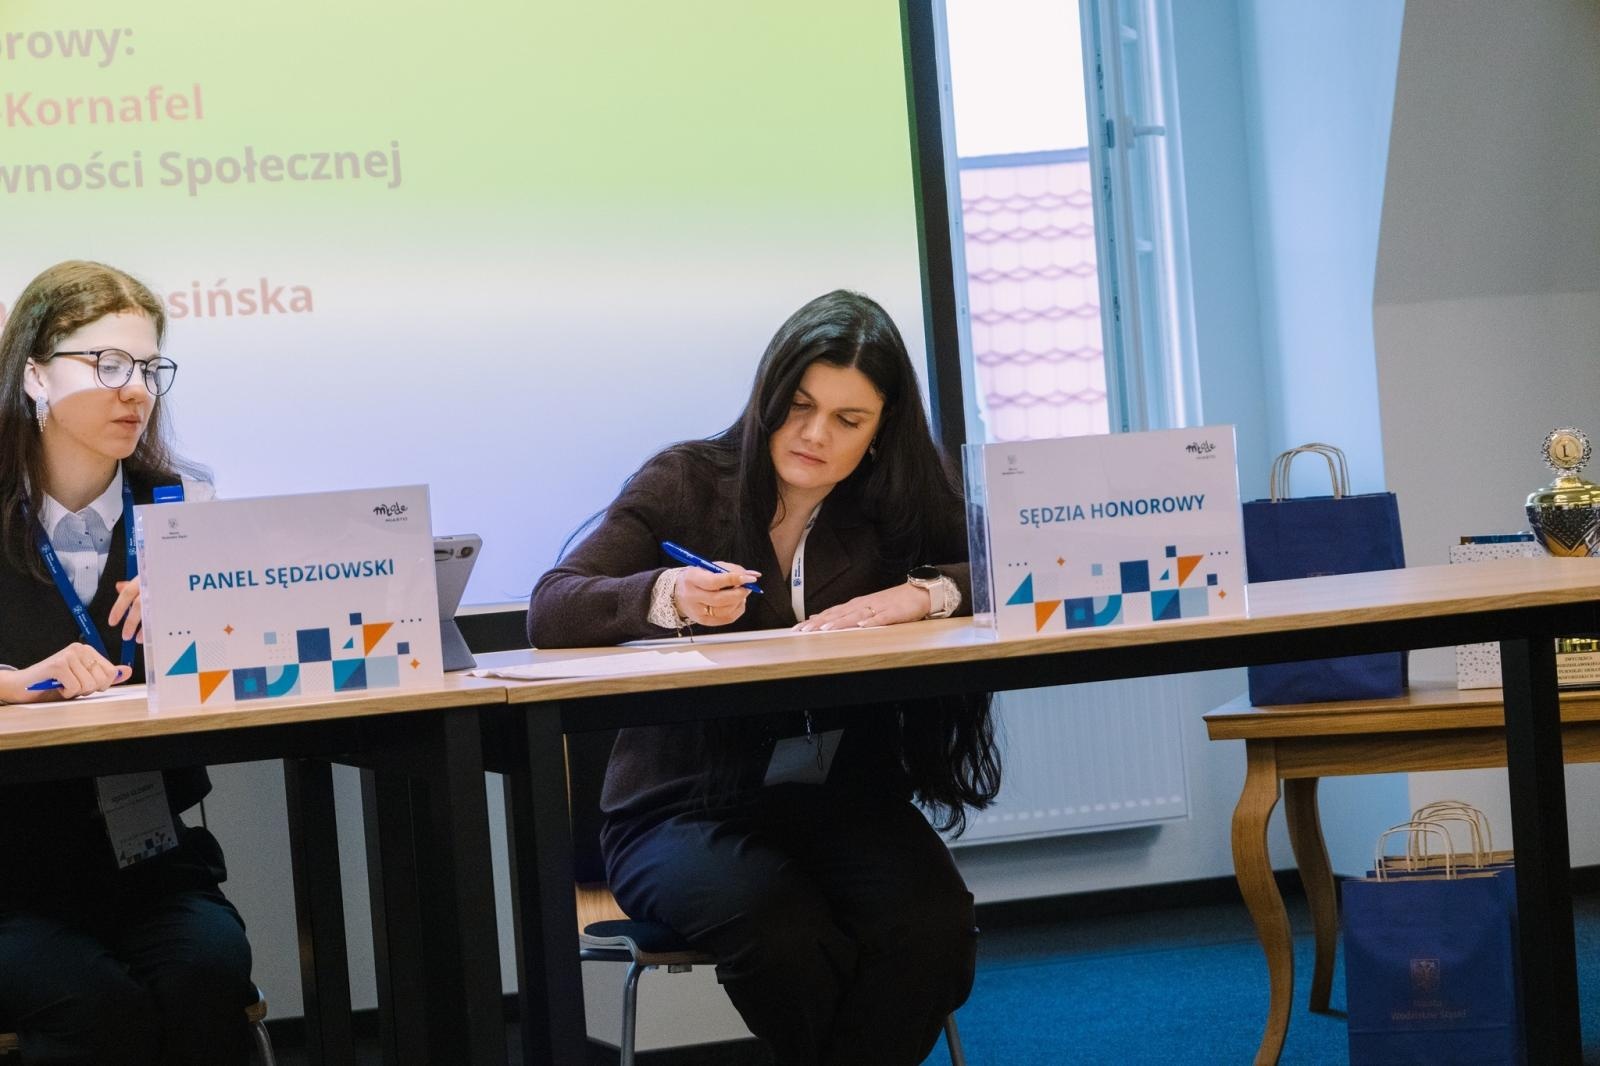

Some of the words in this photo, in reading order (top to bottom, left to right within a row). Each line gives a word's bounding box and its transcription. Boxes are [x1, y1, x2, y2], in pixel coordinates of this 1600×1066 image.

[0, 27, 135, 69] rowy:
[0, 82, 205, 128] Kornafel
[159, 140, 403, 197] Społecznej
[166, 276, 314, 320] sińska
[1019, 504, 1086, 529] SĘDZIA
[1090, 494, 1206, 519] HONOROWY
[188, 570, 259, 592] PANEL
[264, 558, 395, 588] SĘDZIOWSKI
